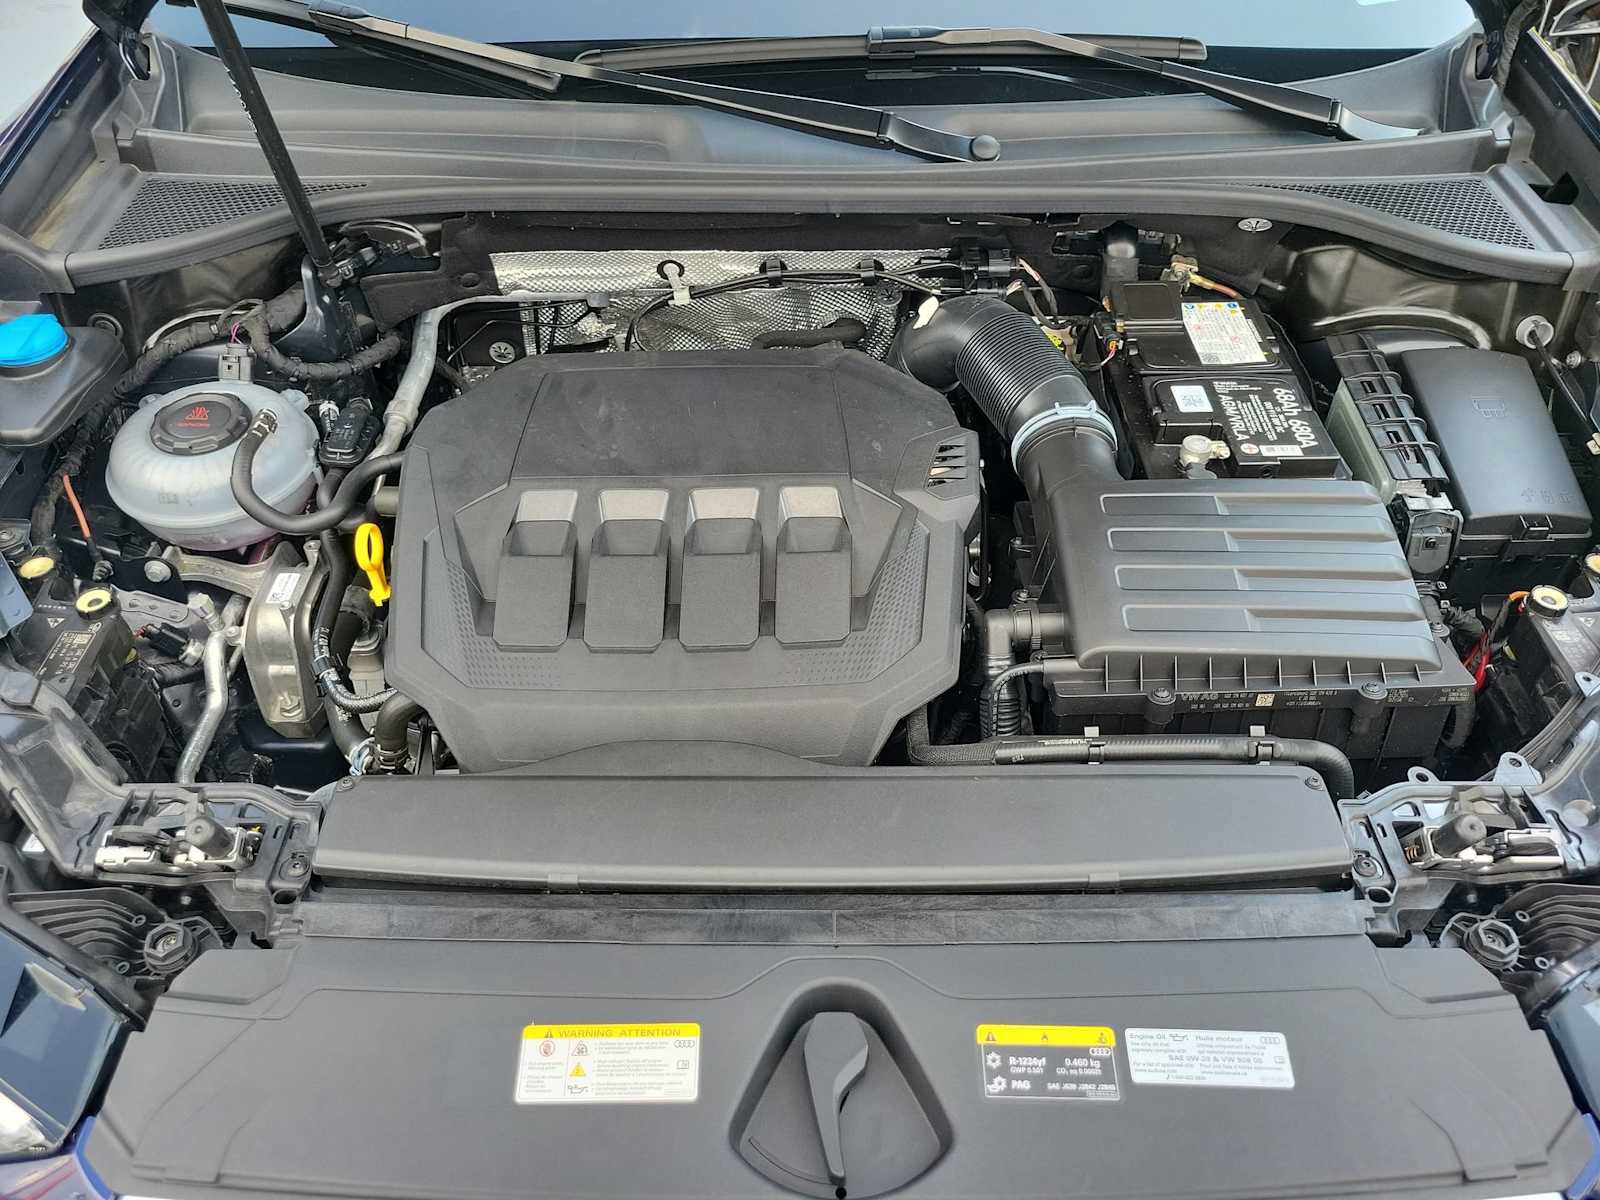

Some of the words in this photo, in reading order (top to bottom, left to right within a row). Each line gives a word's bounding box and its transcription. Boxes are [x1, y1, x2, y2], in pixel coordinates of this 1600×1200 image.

[1218, 394, 1250, 441] AGM/VRLA
[1273, 387, 1302, 416] 68Ah
[1288, 419, 1319, 448] 680A
[1181, 693, 1199, 701] VW
[559, 1030, 614, 1038] WARNING
[619, 1029, 682, 1037] ATTENTION
[1129, 1032, 1154, 1041] Engine
[1009, 1056, 1046, 1067] R-1234yf
[1065, 1058, 1088, 1067] 0.460
[1089, 1058, 1101, 1069] kg
[1011, 1079, 1032, 1089] PAG
